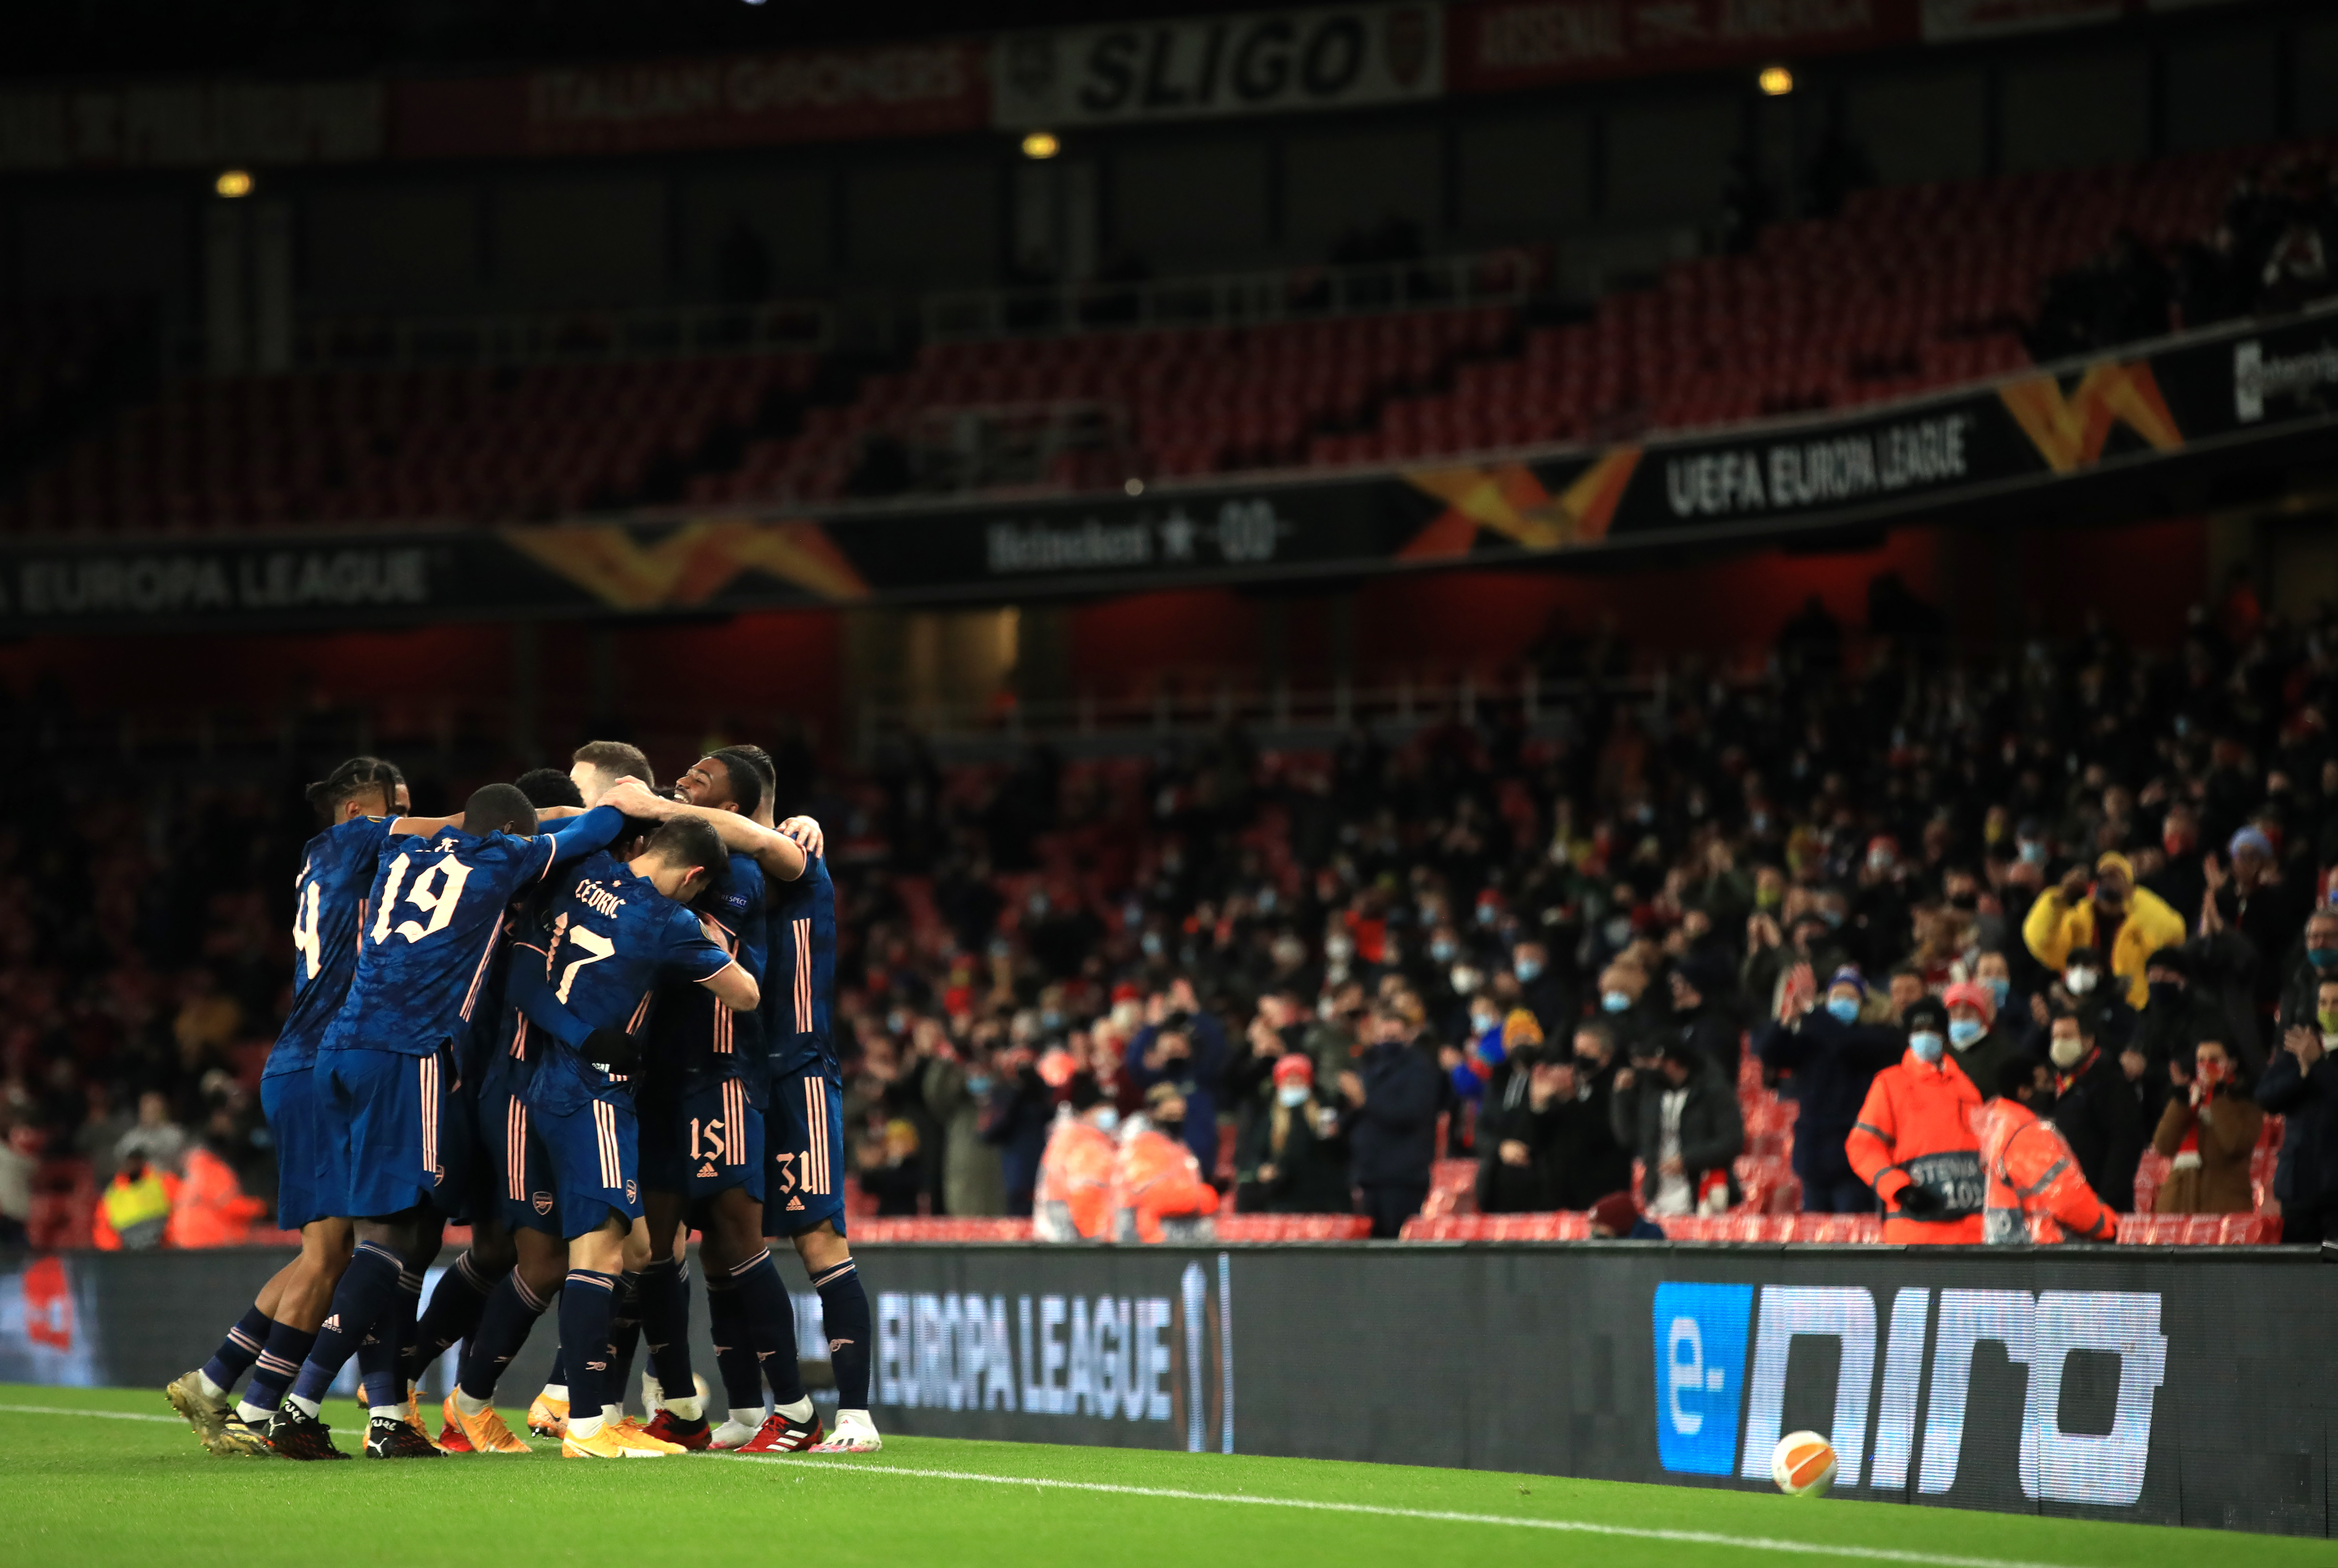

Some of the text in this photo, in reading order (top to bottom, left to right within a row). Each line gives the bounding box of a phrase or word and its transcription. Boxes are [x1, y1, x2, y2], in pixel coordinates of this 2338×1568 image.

[1080, 16, 1365, 112] SLIGO
[1666, 450, 1766, 518] UEFA
[1767, 434, 1879, 507] EUROPA
[19, 553, 231, 614] EUROPA
[238, 548, 429, 607] LEAGUE
[370, 851, 474, 946] 19
[575, 878, 627, 919] CÉDRIC
[721, 894, 747, 907] RESPECT
[546, 912, 616, 1006] 17
[689, 1117, 725, 1161] 15
[776, 1150, 813, 1195] 31
[877, 1291, 1016, 1413] EUROPA
[1018, 1292, 1172, 1422] LEAGUE
